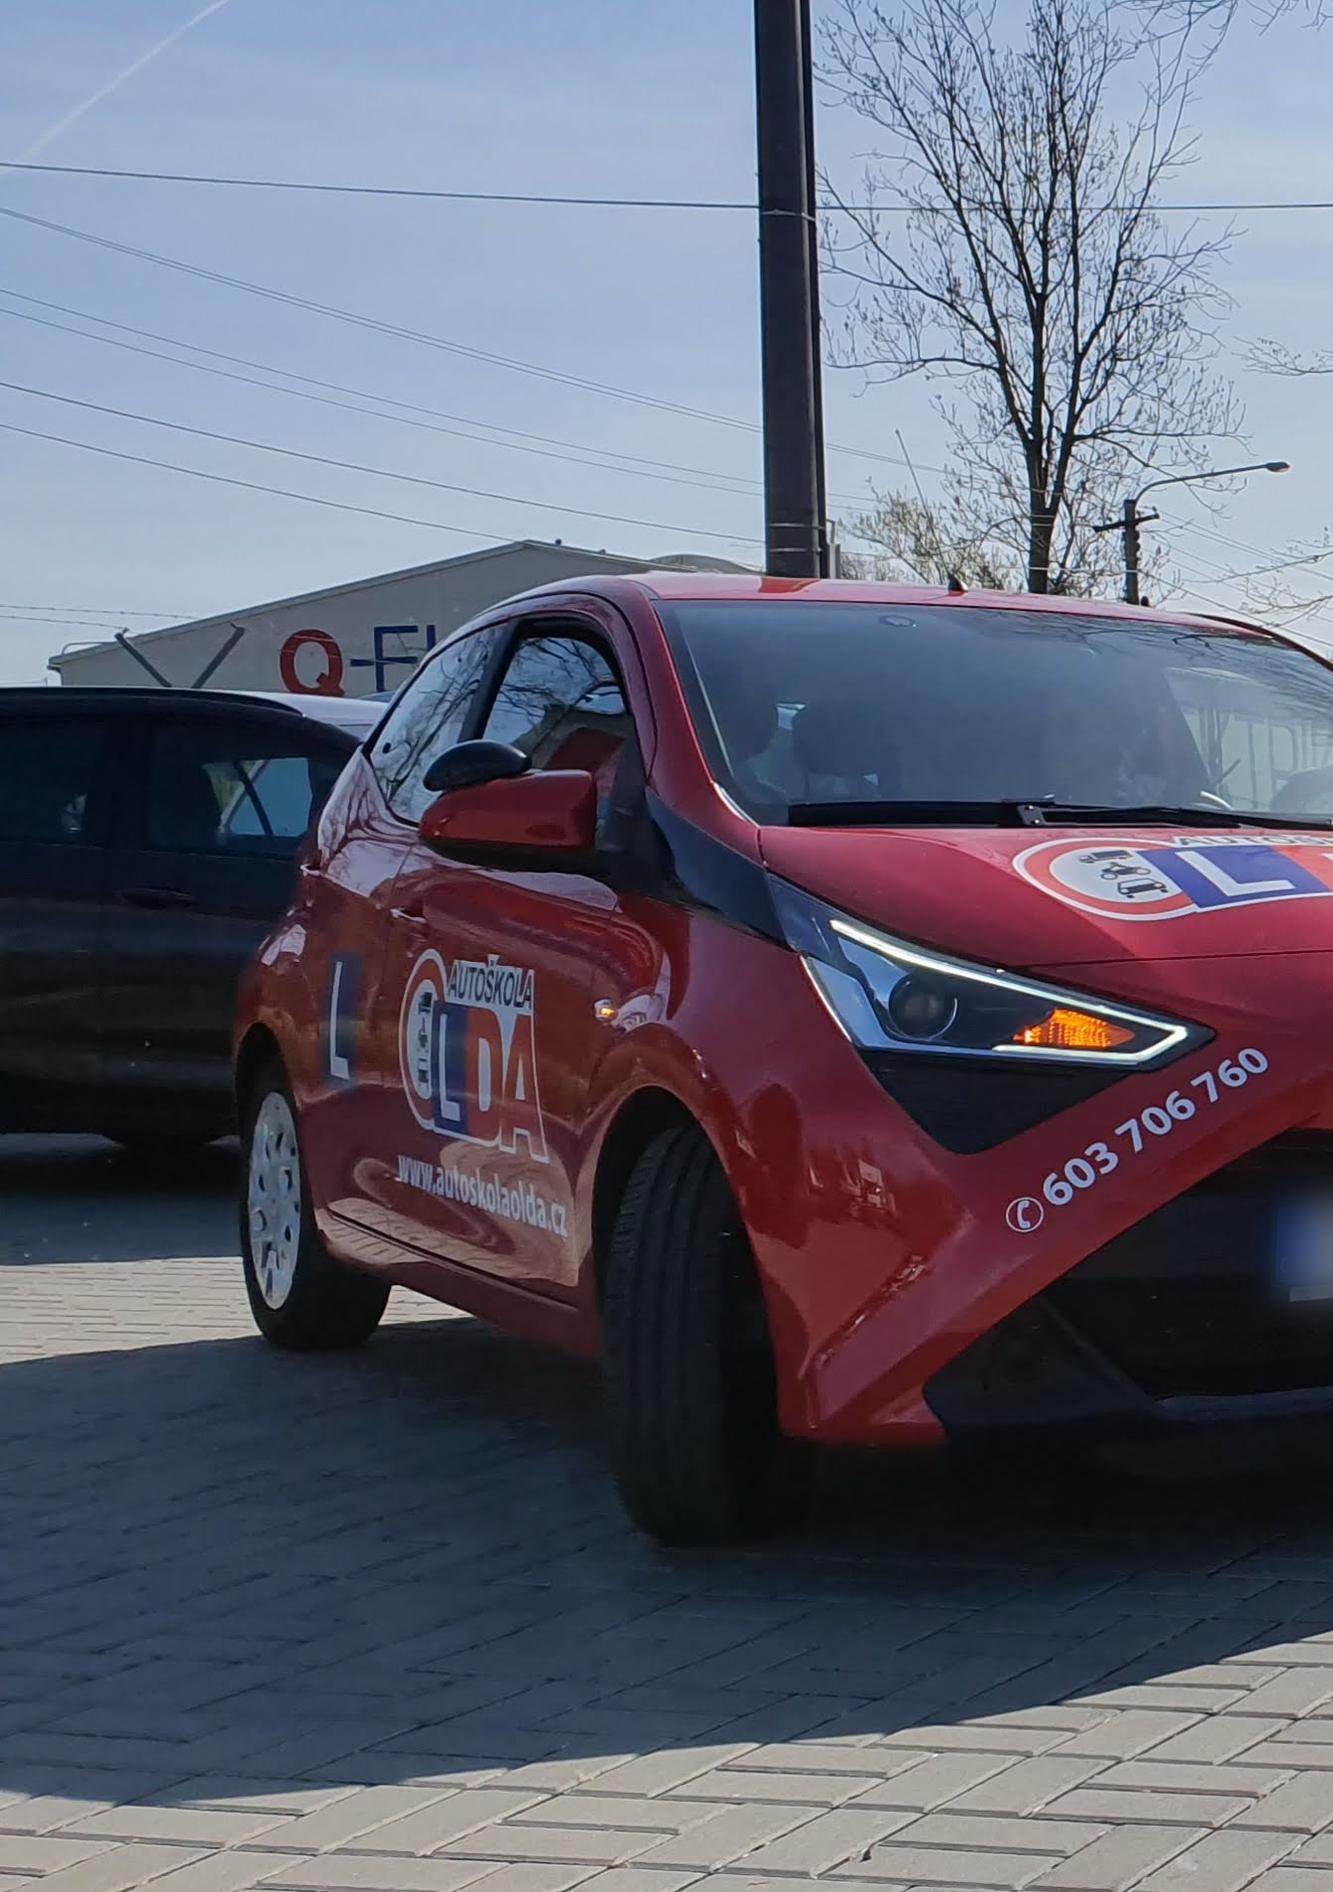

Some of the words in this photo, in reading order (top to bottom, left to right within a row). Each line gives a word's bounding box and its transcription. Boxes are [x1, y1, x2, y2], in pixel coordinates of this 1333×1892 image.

[330, 960, 350, 1080] L
[447, 955, 534, 1010] AUTOŠKOLA
[1042, 1142, 1119, 1206] 603
[1114, 1090, 1197, 1153] 706
[1190, 1048, 1269, 1103] 760
[398, 1154, 568, 1239] www.autoskolaolda.cz
